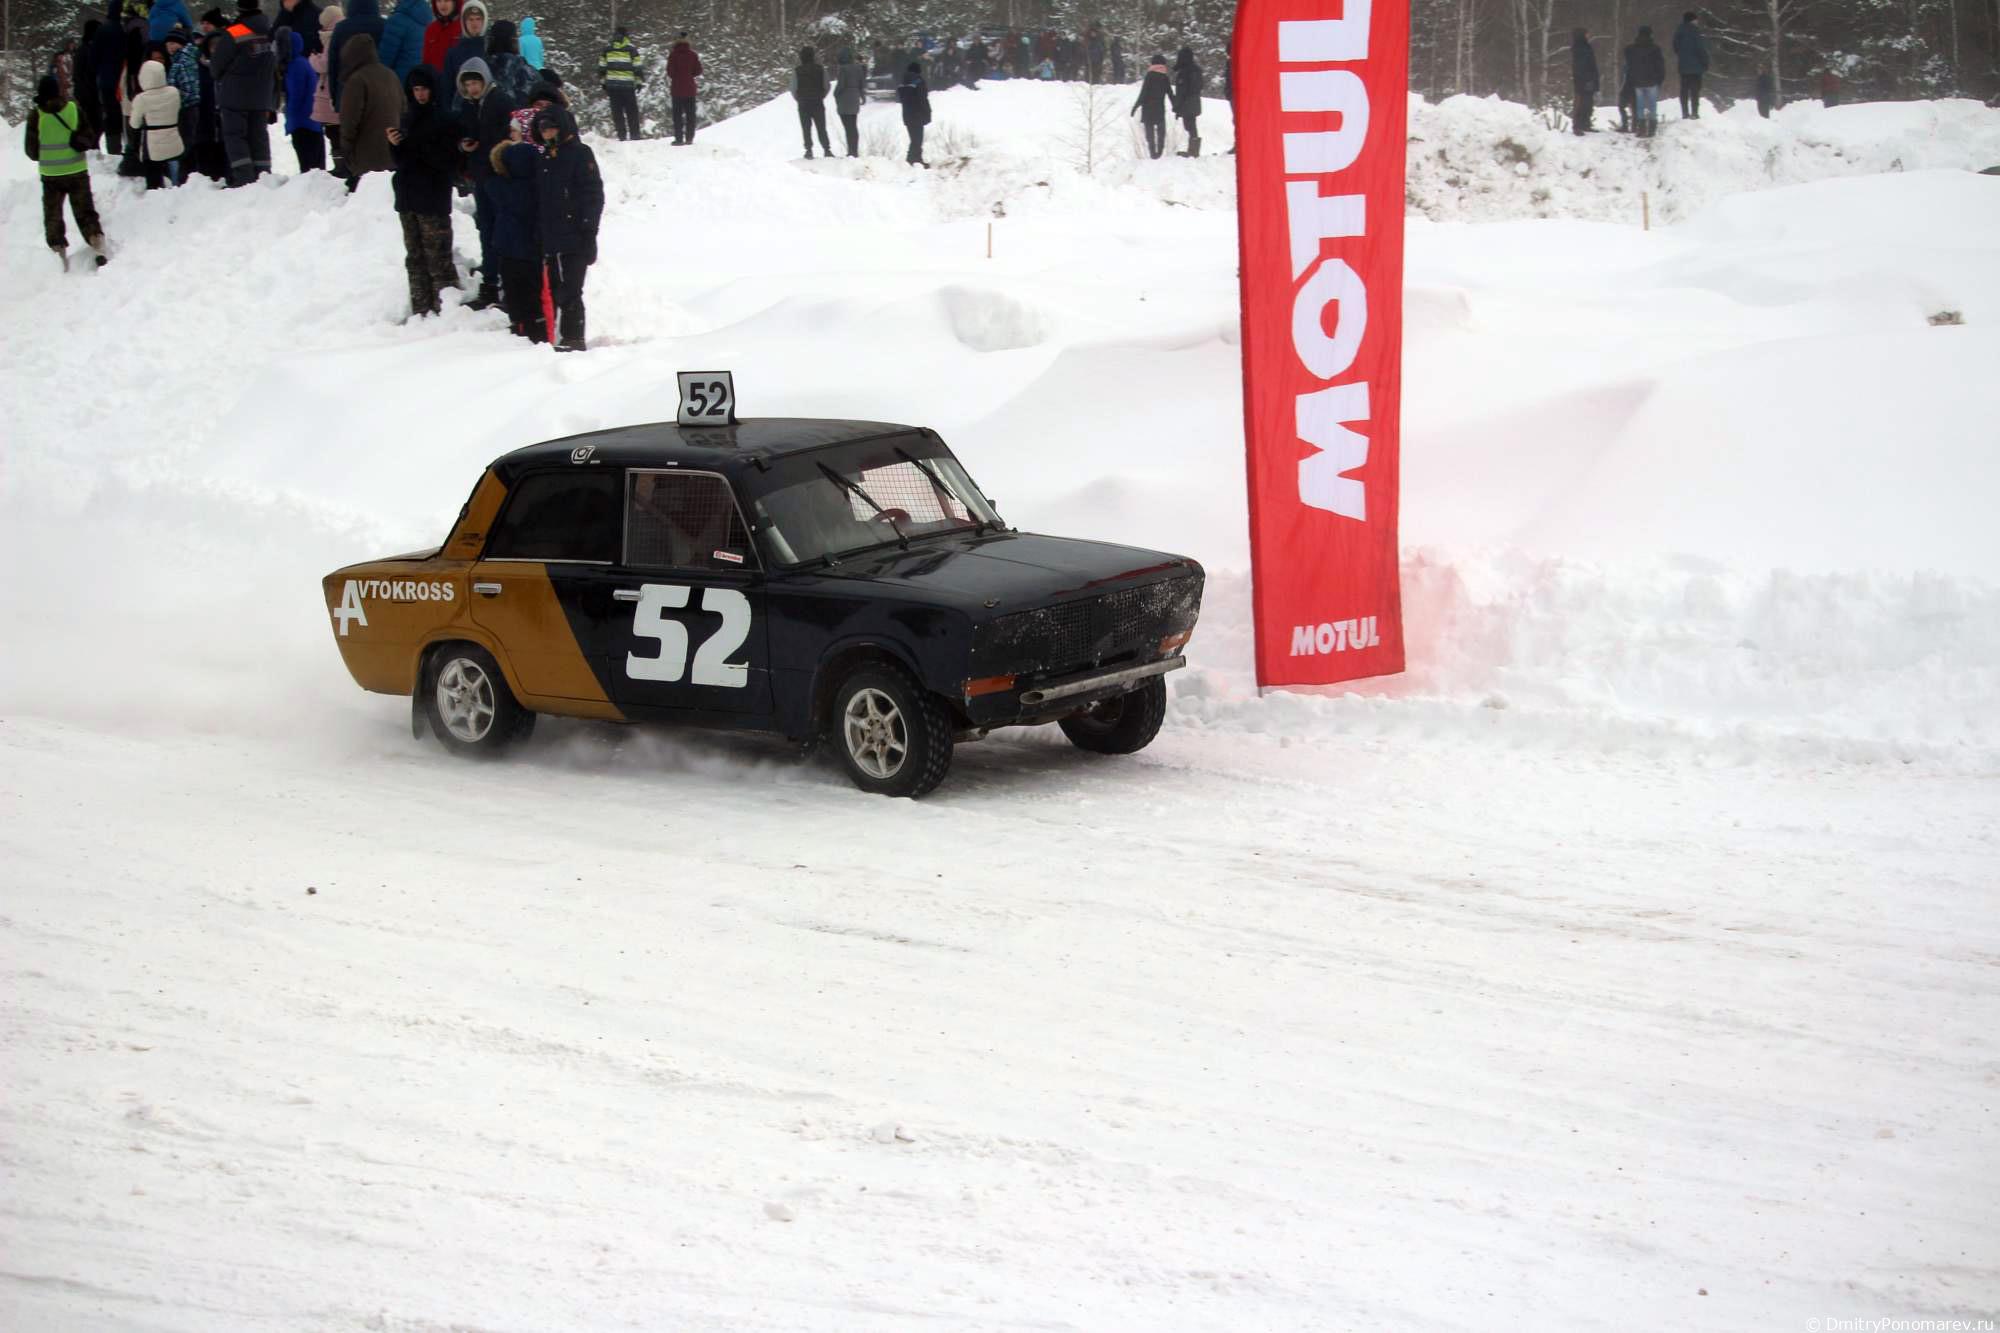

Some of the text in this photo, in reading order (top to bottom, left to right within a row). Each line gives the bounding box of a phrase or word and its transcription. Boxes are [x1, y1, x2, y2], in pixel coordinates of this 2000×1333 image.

[1278, 0, 1372, 522] MOTUL
[687, 381, 727, 417] 52
[333, 579, 455, 636] AVTOKROSS
[626, 583, 752, 688] 52
[1289, 615, 1380, 656] MOTUL
